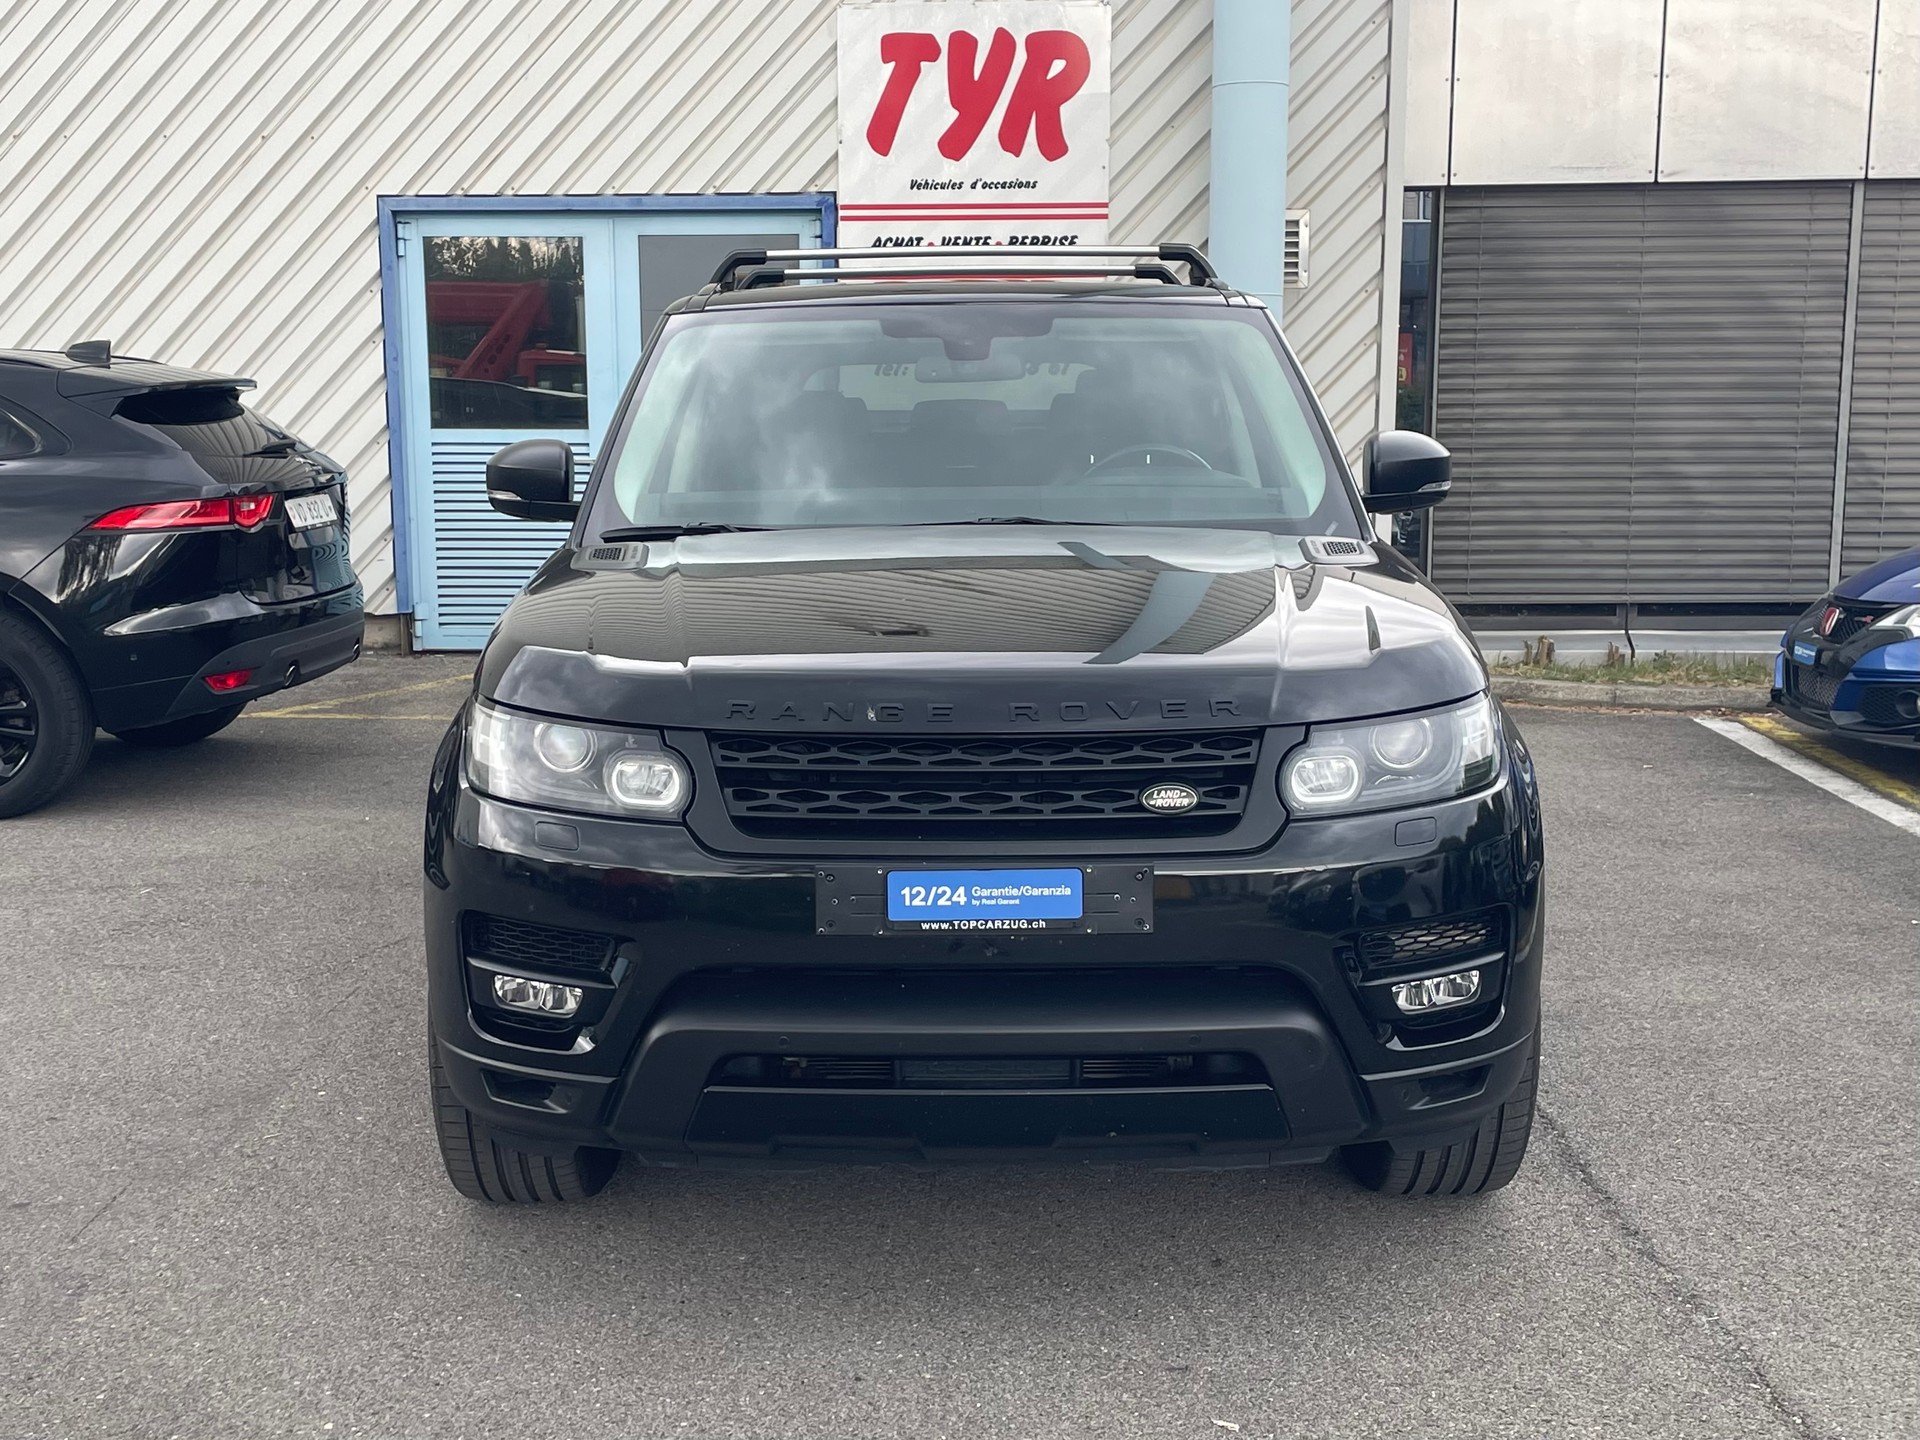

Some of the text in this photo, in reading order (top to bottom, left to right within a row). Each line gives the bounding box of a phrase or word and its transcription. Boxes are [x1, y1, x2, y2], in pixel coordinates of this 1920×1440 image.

[866, 26, 1091, 162] TYR
[909, 177, 1038, 190] Véhicules d'occasions
[725, 698, 1241, 723] RANGE ROVER
[1152, 790, 1181, 799] LAND
[1155, 798, 1190, 807] ROVER
[901, 886, 967, 906] 12/24
[971, 884, 1072, 896] Garantie/Garanzia
[971, 898, 981, 907] by
[921, 919, 1046, 930] www.TOPCARZUG.ch
